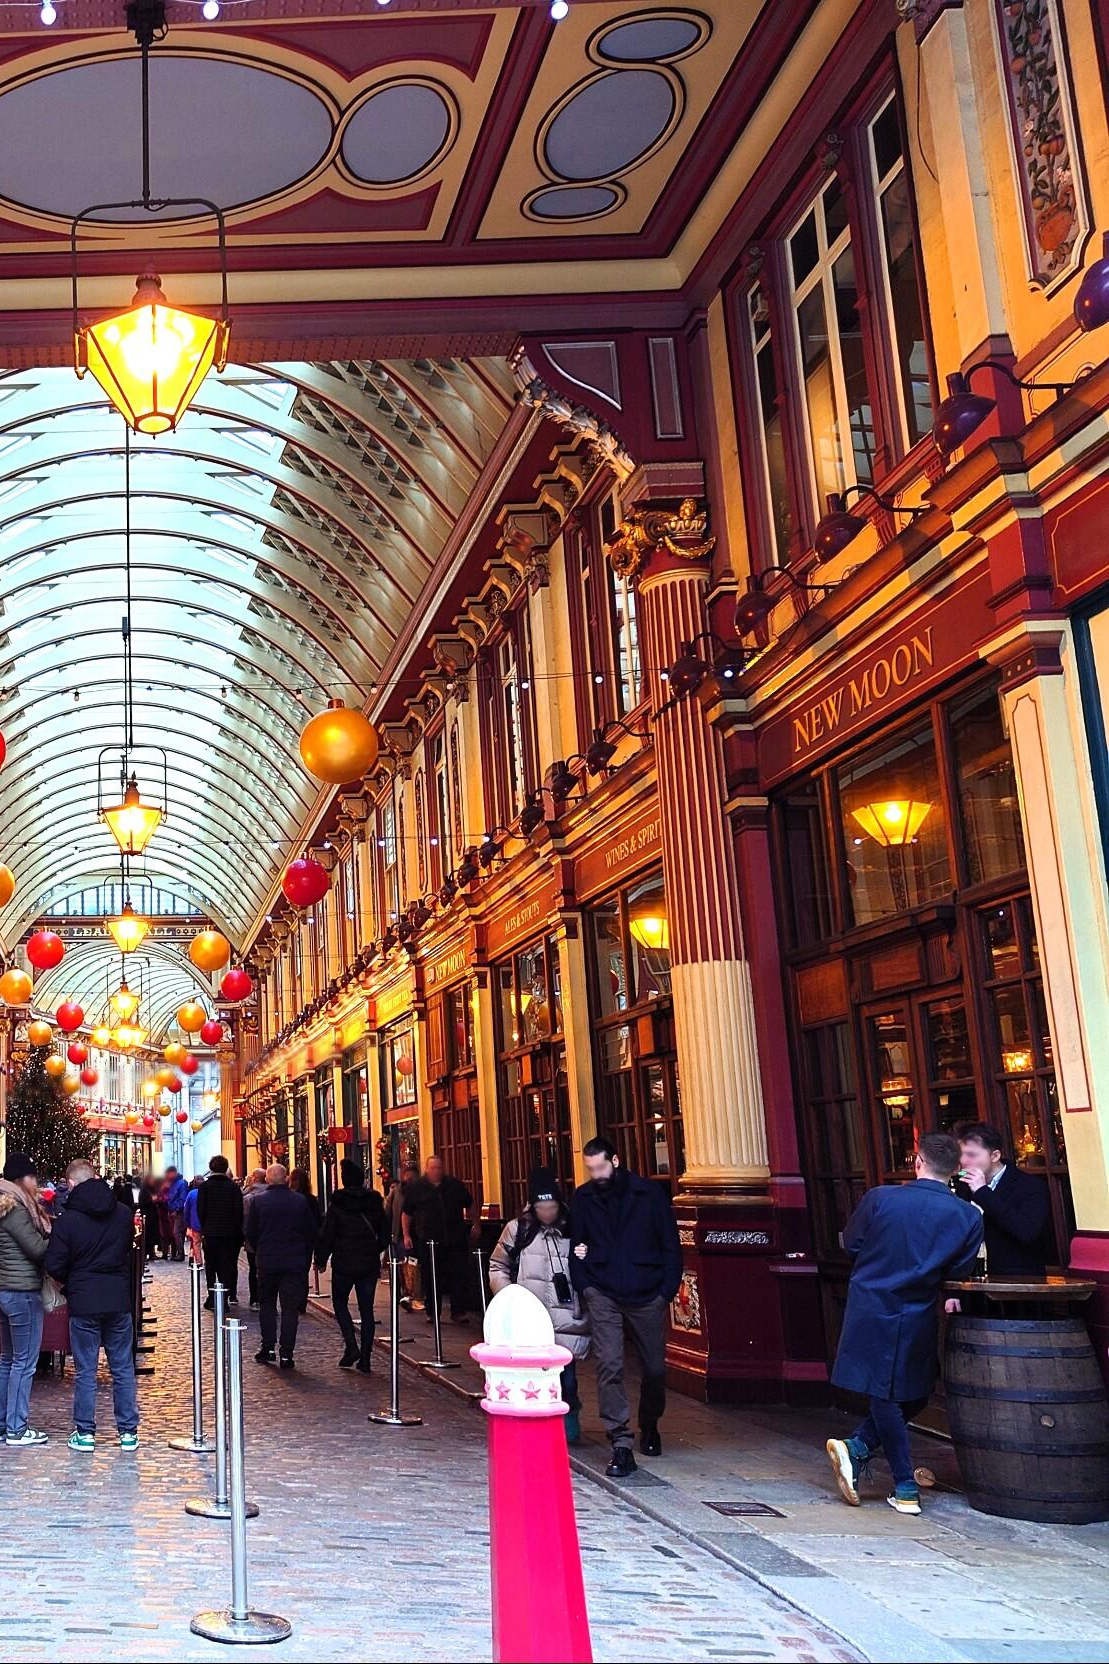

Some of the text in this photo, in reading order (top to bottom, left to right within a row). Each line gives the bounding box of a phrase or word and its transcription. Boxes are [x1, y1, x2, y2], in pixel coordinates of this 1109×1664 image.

[792, 626, 933, 753] NEW MOON
[605, 840, 629, 869] WINES
[630, 836, 637, 854] &
[435, 948, 466, 982] NEW MOON
